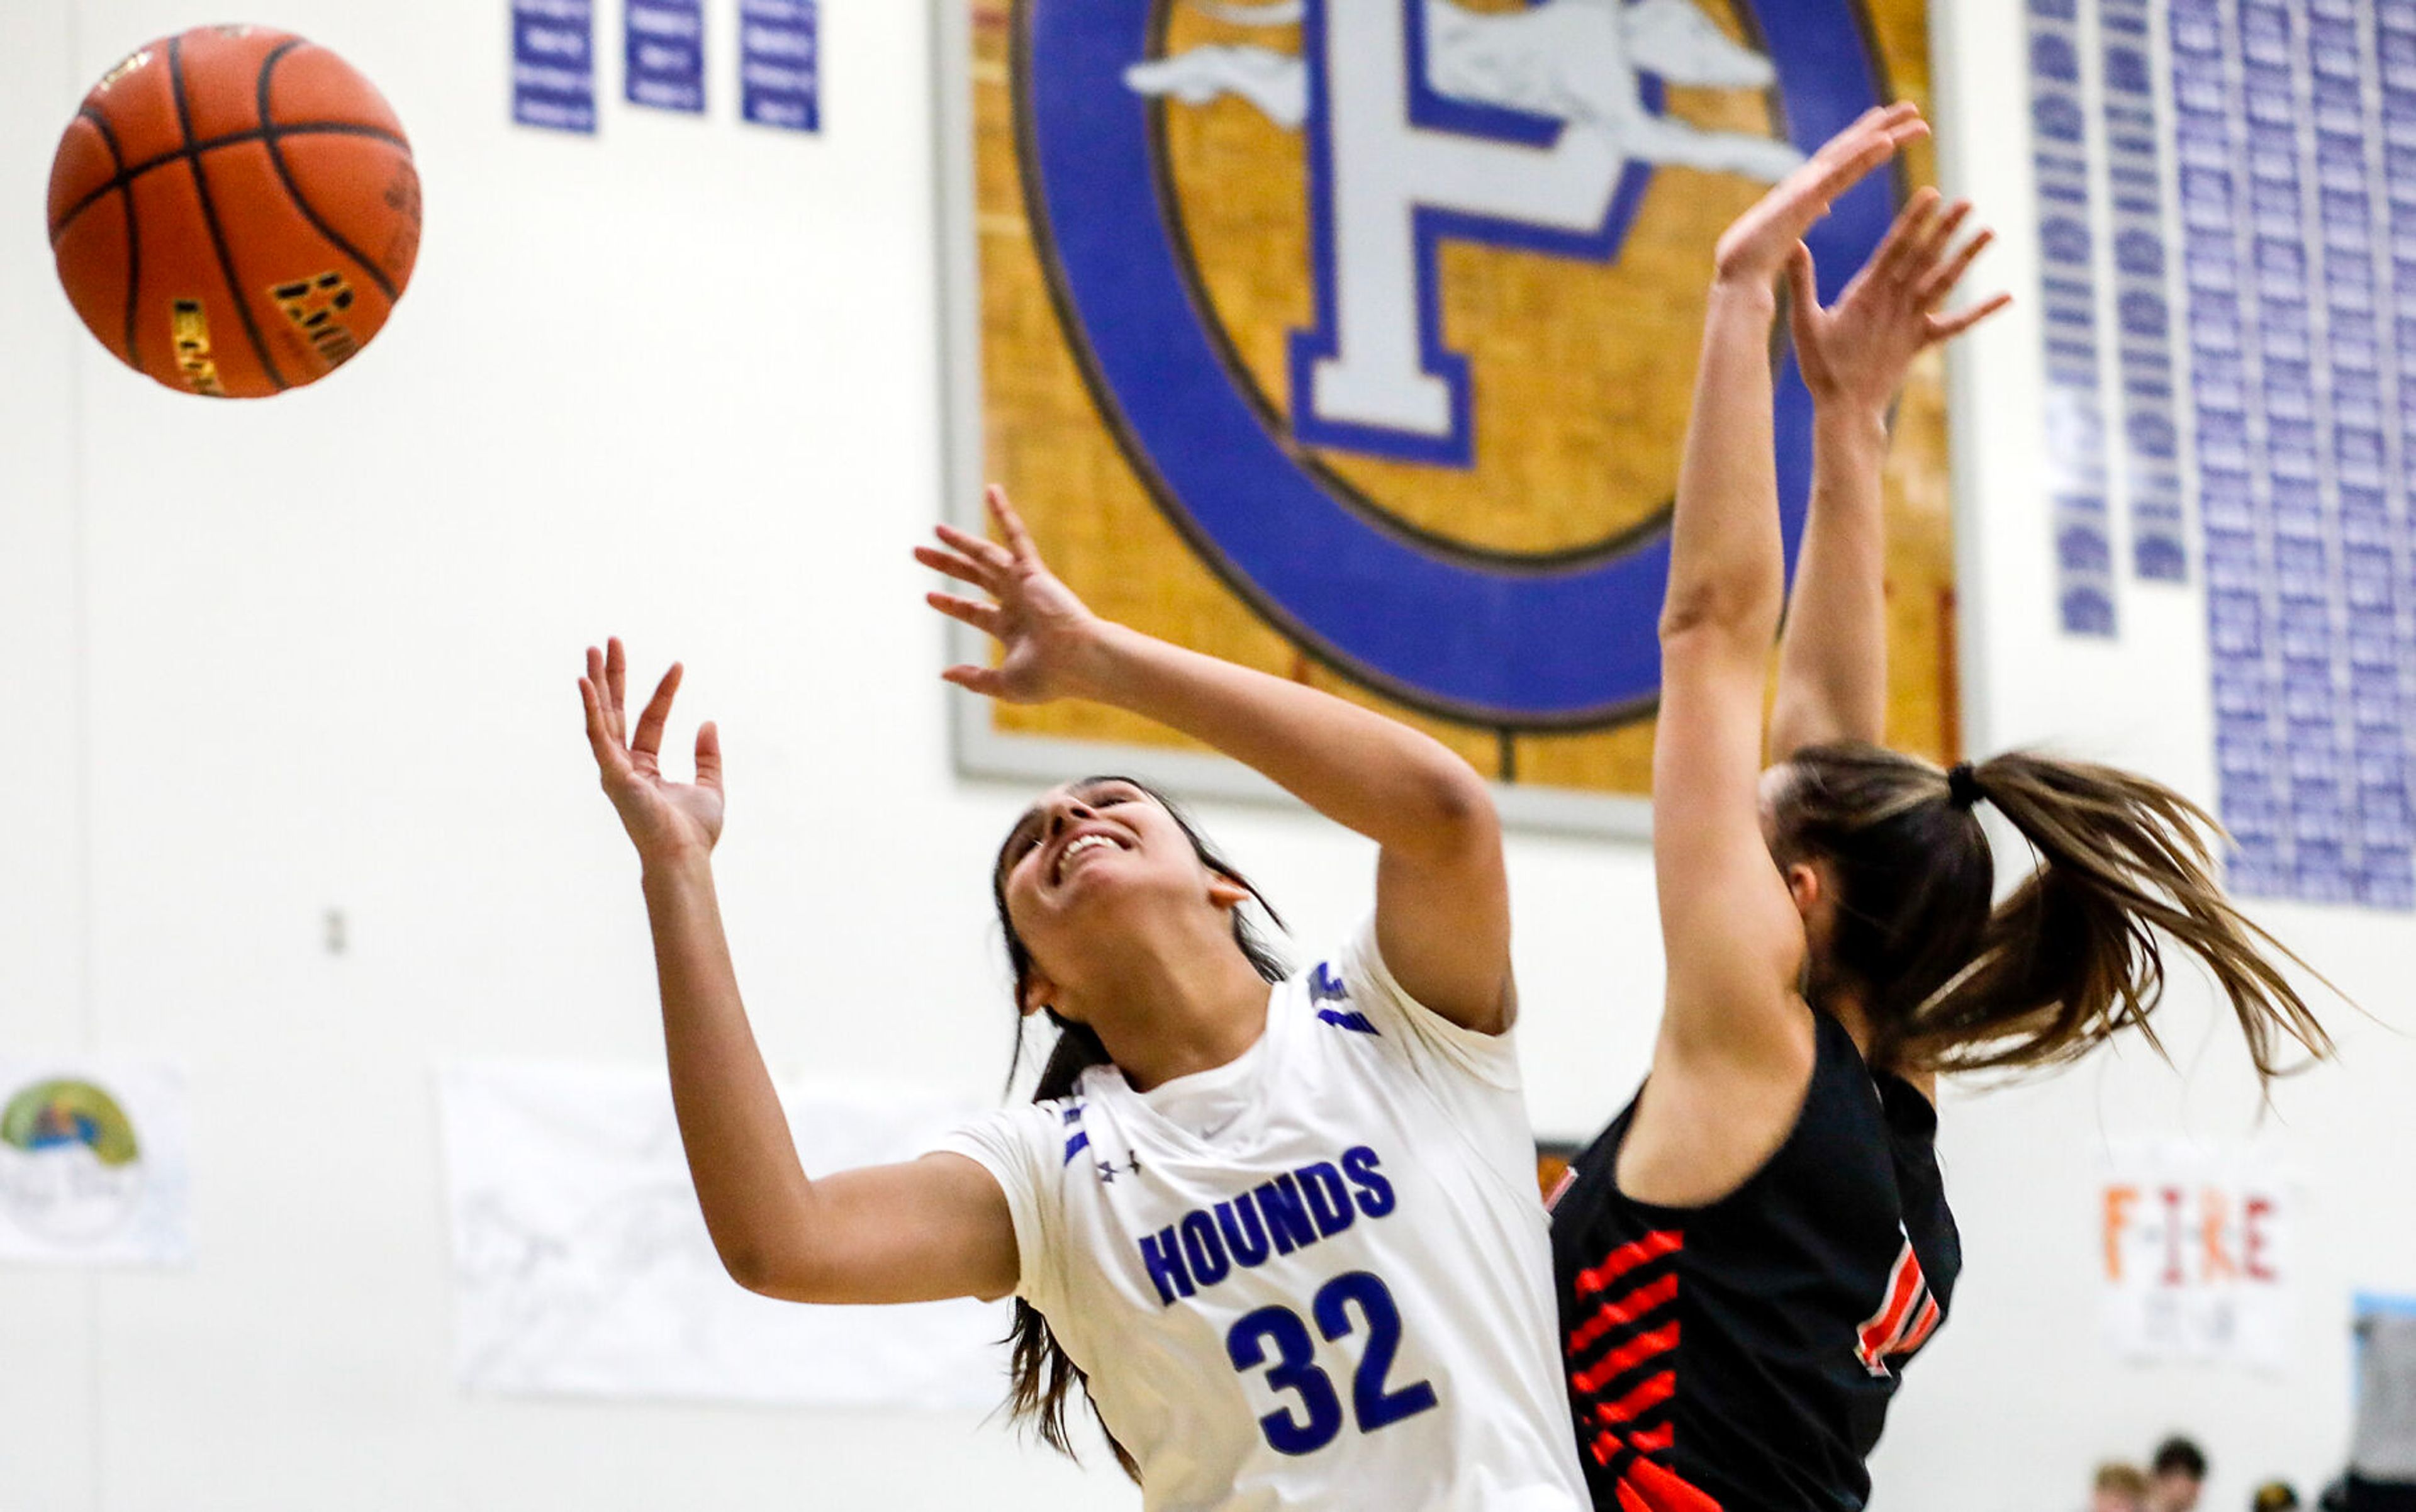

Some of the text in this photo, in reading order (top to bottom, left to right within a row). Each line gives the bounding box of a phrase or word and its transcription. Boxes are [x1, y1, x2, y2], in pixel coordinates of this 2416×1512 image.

[1138, 1145, 1396, 1307] HOUNDS
[2100, 1184, 2274, 1285] FIRE
[1226, 1270, 1438, 1456] 32
